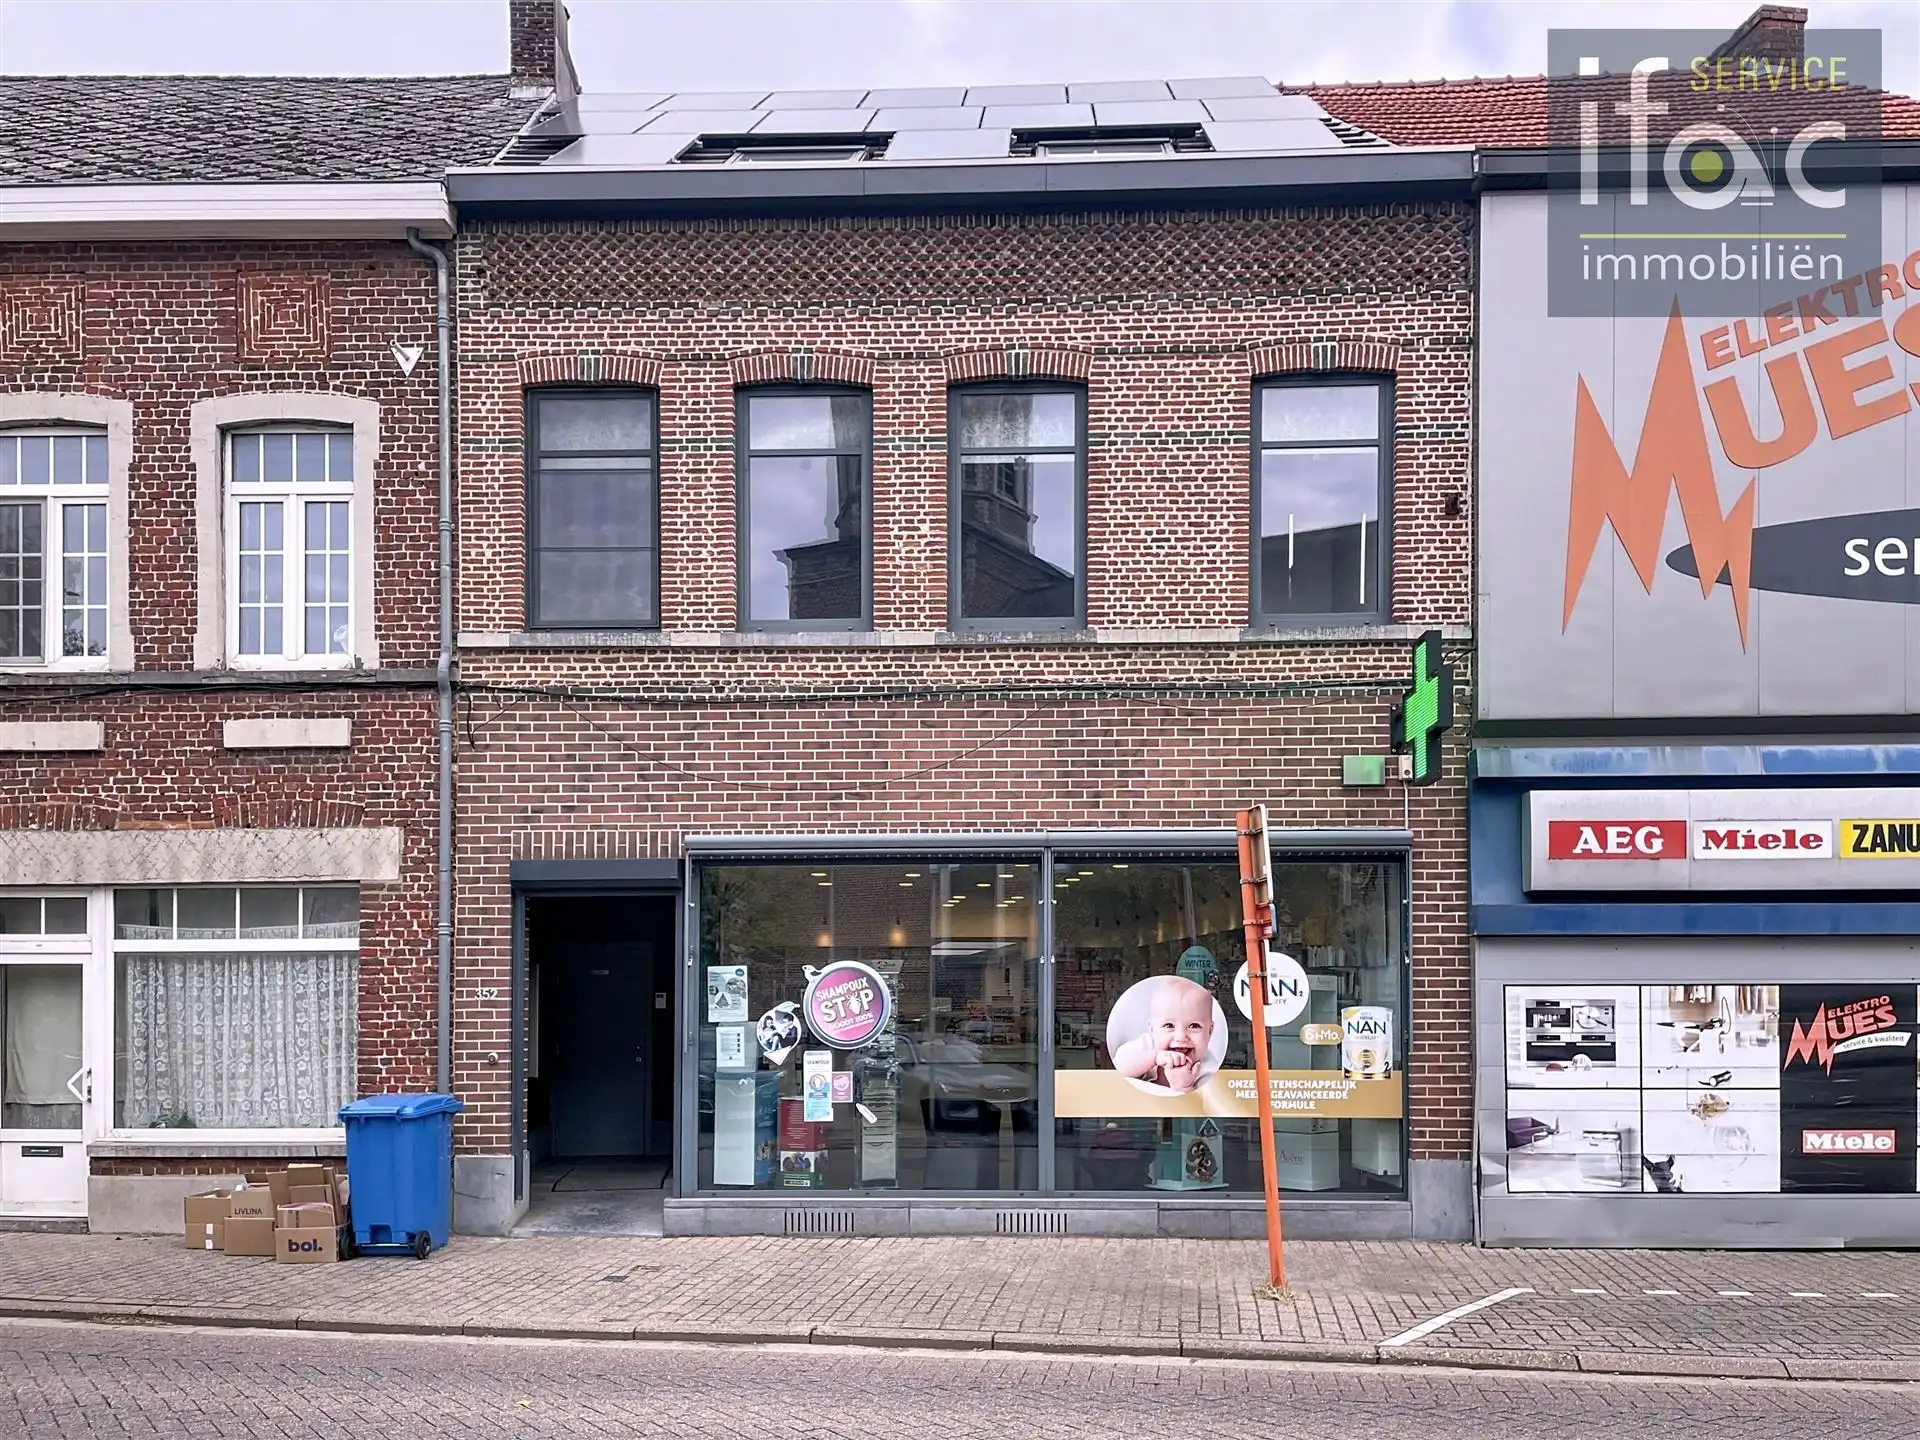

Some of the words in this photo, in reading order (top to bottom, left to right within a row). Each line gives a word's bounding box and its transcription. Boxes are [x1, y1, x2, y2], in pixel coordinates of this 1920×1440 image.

[1572, 826, 1664, 855] AEG
[1702, 829, 1823, 850] Miele
[474, 988, 498, 1000] 352
[816, 977, 870, 1001] SHAMPOUX
[1828, 995, 1890, 1018] ELEKTRO
[1305, 1028, 1314, 1040] 6
[1347, 1020, 1387, 1034] NAN
[1783, 1002, 1897, 1077] MUES
[1843, 1039, 1866, 1049] service
[1874, 1035, 1904, 1043] kwaliteit
[1228, 1080, 1255, 1088] ONZE
[1271, 1090, 1349, 1099] GEAVANCEERDE
[1805, 1132, 1892, 1151] Miele
[288, 1238, 323, 1253] bol.
